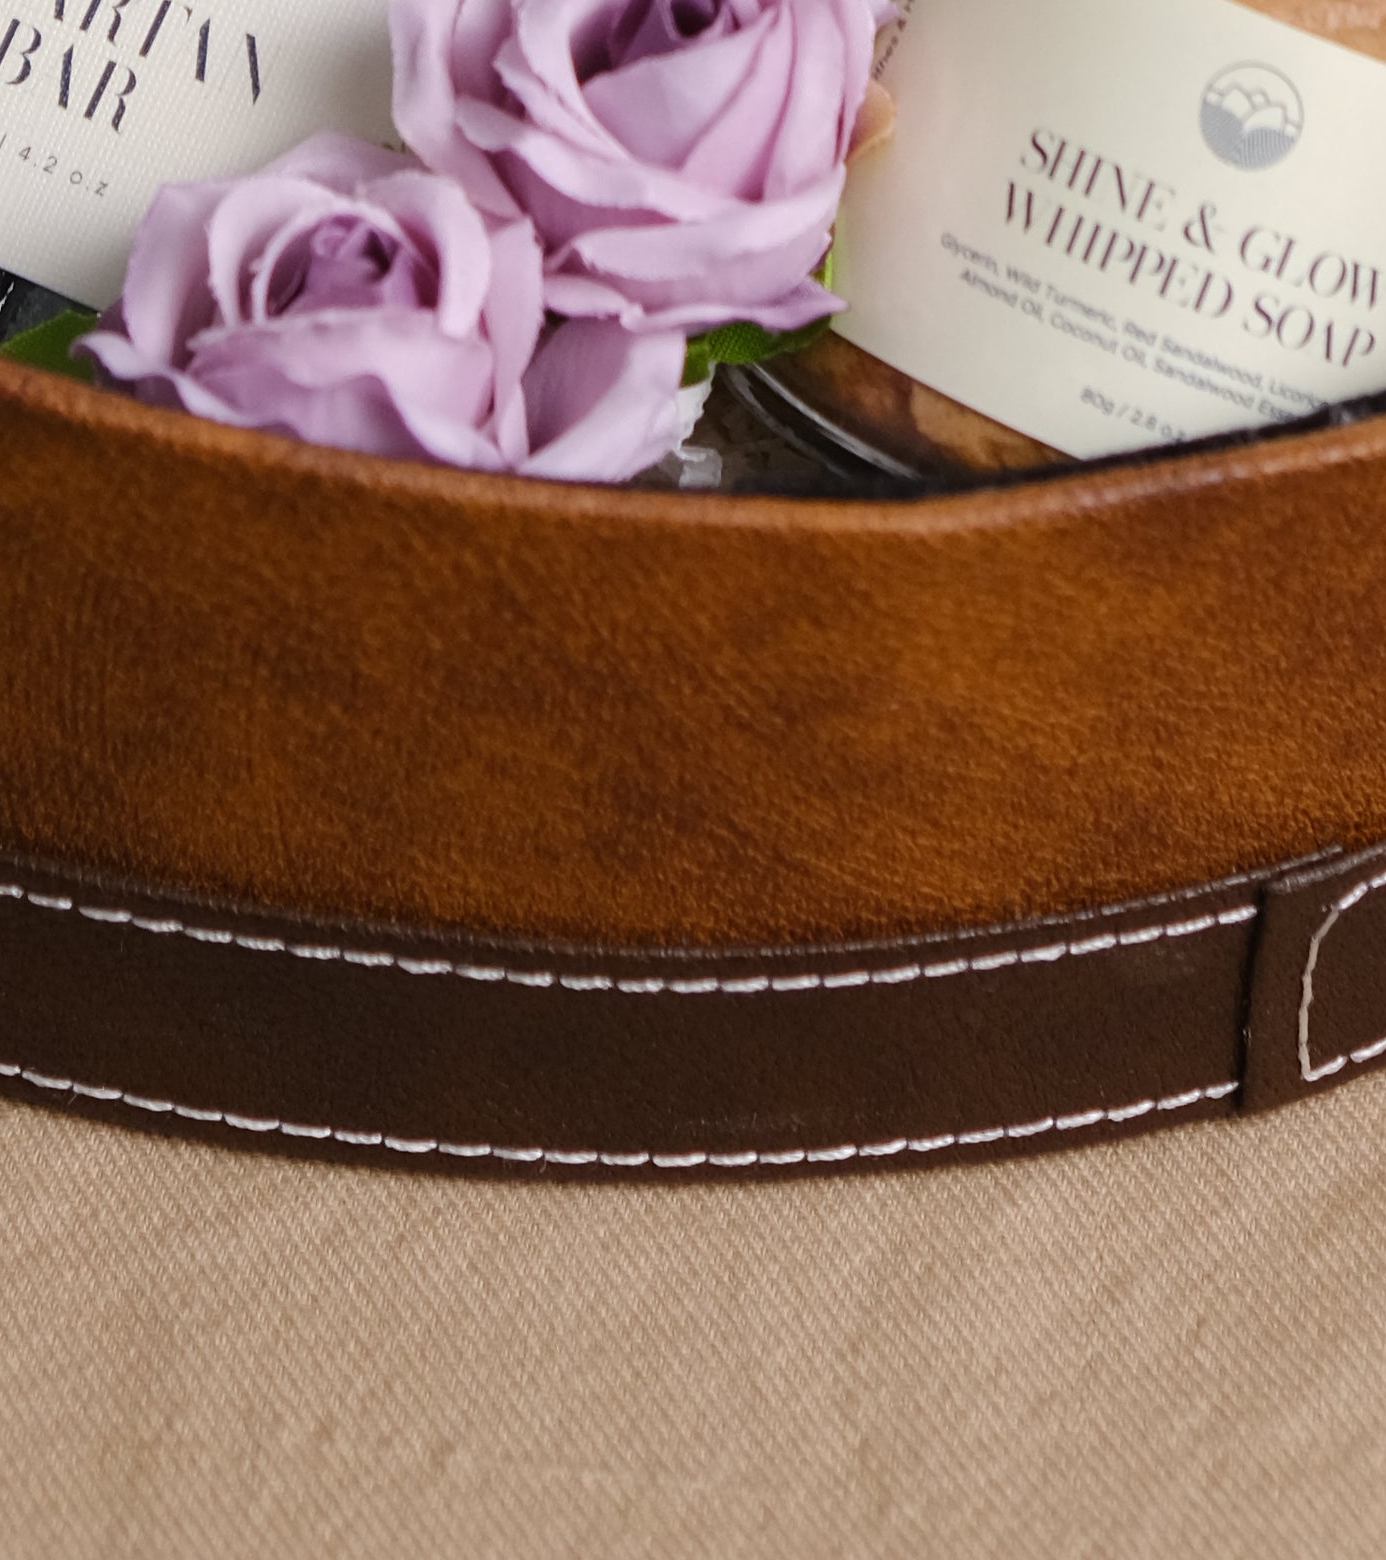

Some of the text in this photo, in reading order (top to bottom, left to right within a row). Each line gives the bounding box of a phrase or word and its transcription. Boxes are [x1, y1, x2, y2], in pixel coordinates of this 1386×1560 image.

[18, 146, 58, 175] 4.2
[1021, 127, 1176, 231] SHINE
[1182, 200, 1225, 254] &
[1005, 181, 1376, 368] WHIPPED SOAP
